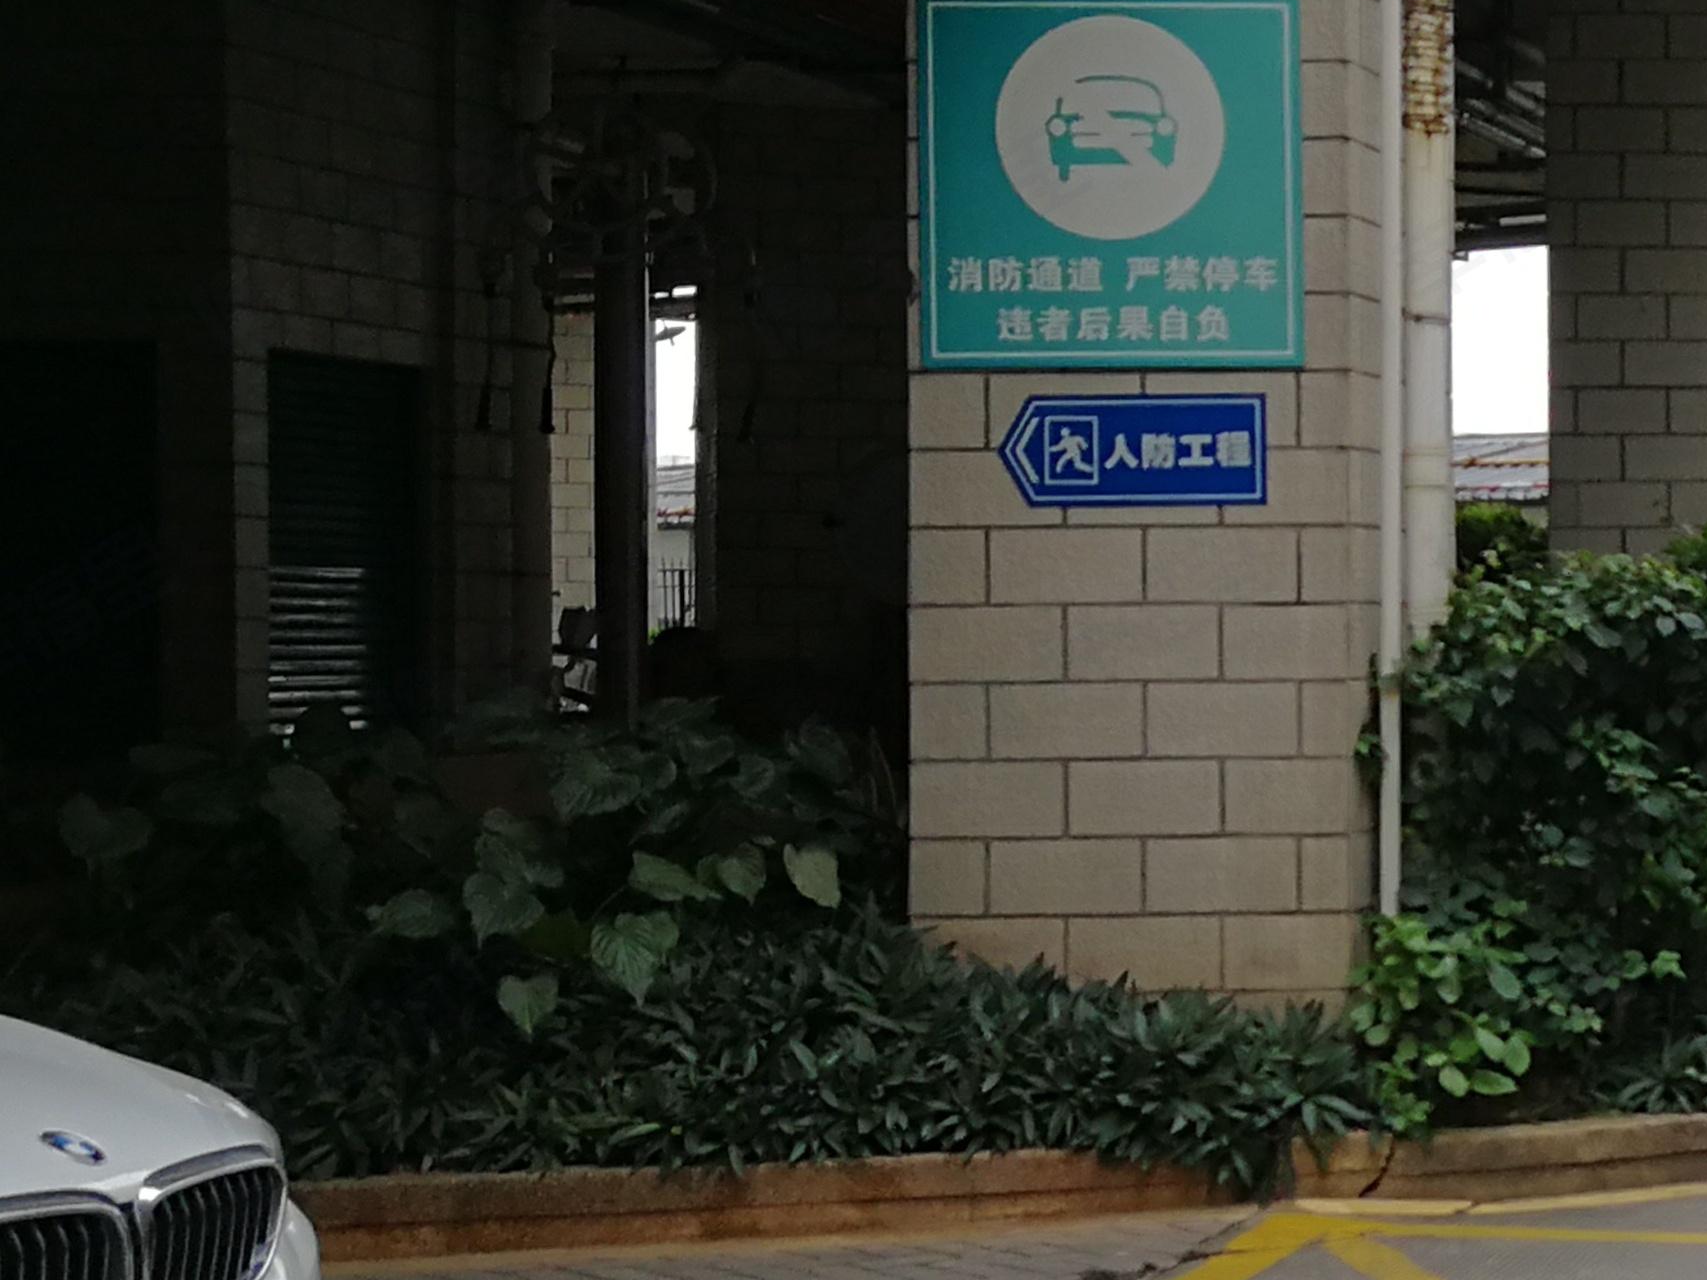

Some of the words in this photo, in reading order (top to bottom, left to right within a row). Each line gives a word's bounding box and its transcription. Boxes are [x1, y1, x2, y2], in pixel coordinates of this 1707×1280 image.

[948, 257, 1103, 293] 消防通道
[1125, 257, 1278, 293] 严禁停车
[998, 306, 1230, 342] 违者后果自负
[1105, 431, 1253, 469] 人防工程
